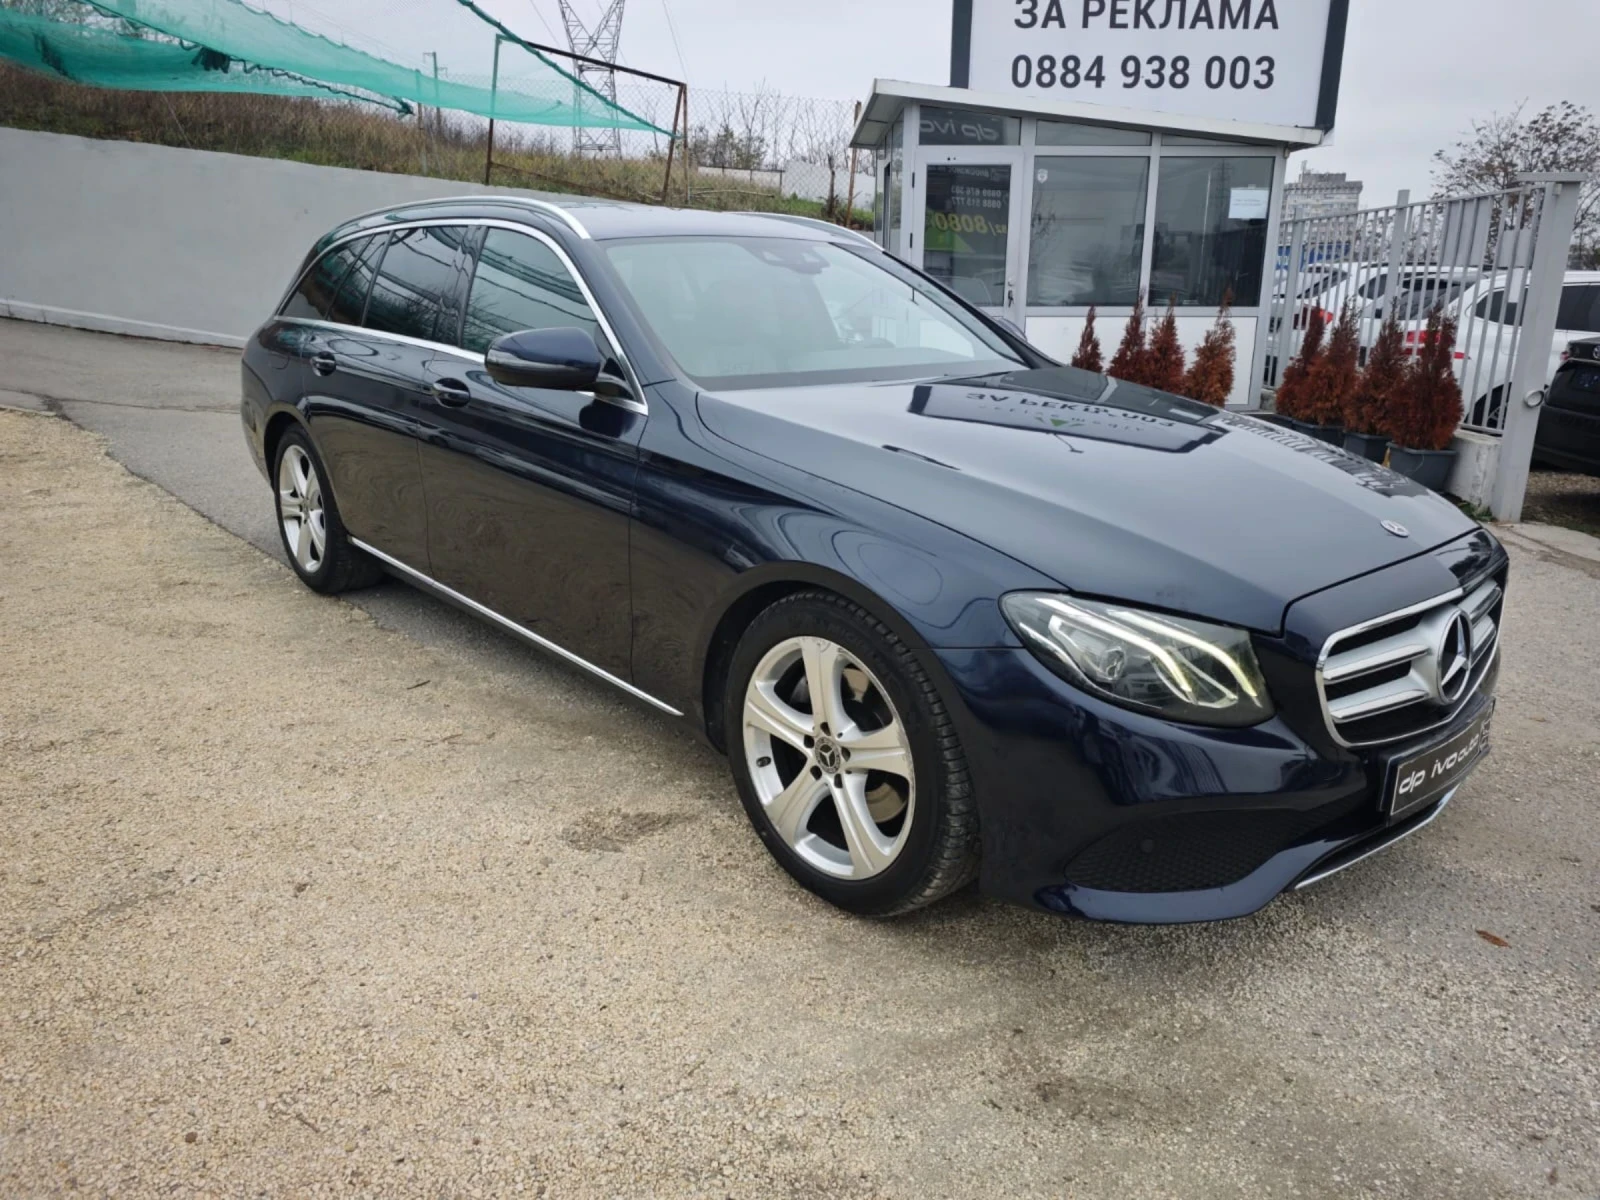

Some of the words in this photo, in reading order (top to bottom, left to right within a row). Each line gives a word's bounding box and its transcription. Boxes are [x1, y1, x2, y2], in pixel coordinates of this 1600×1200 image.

[1013, 0, 1067, 29] ЗА
[1081, 0, 1280, 30] РЕКЛАМА
[1010, 54, 1106, 89] 0884
[1120, 55, 1190, 89] 938
[1204, 55, 1276, 90] 003
[1398, 769, 1426, 795] dp
[1430, 751, 1459, 779] ivo
